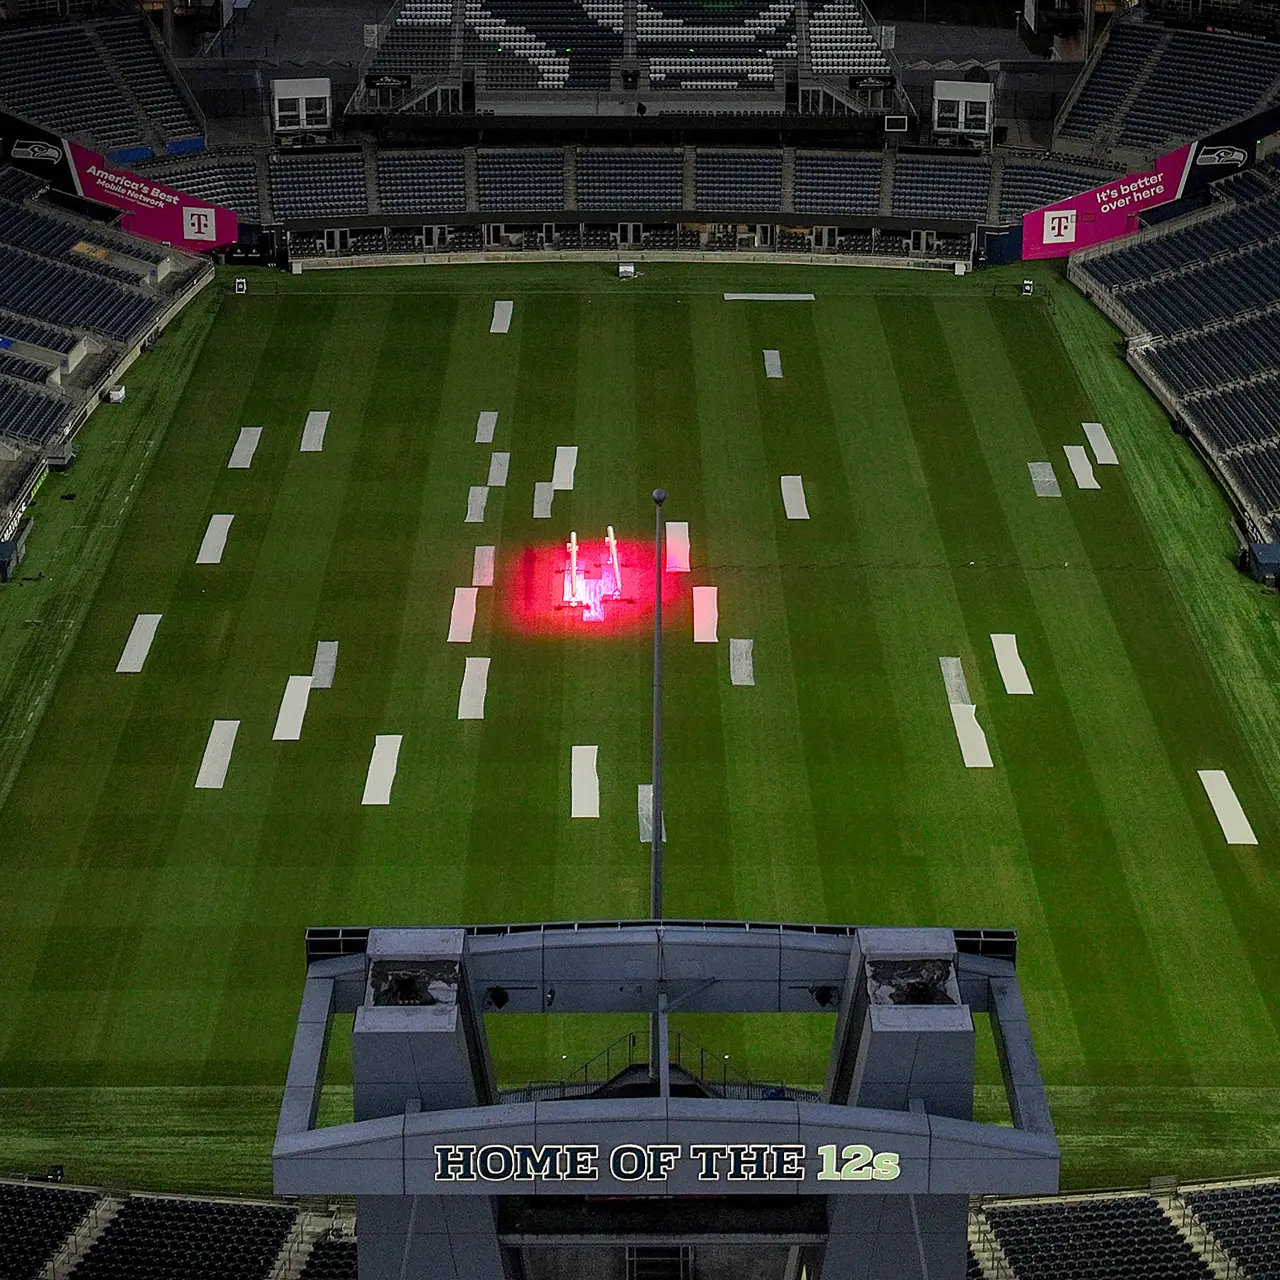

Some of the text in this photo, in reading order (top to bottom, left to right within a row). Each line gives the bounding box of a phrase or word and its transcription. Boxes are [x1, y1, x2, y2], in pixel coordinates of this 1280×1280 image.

[86, 165, 150, 194] America's
[150, 187, 180, 205] Best
[96, 178, 127, 194] Mobile
[126, 189, 165, 209] Network
[1096, 172, 1164, 204] It's better
[1100, 184, 1165, 214] over here
[433, 1143, 901, 1182] HOME OF THE 12s
